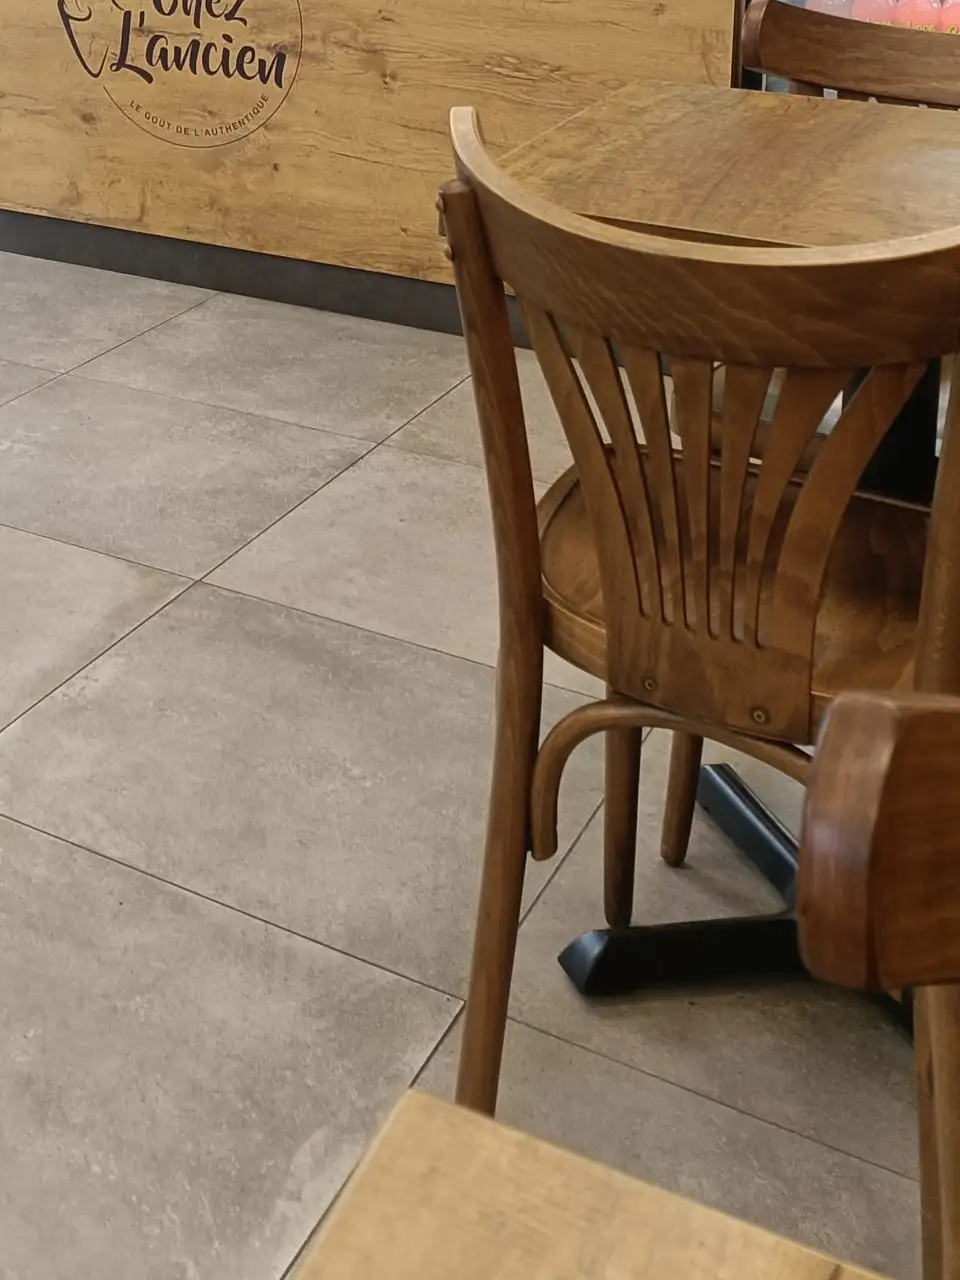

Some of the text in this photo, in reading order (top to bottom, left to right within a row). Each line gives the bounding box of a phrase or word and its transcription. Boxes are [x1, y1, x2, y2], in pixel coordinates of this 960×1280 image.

[110, 10, 287, 89] L'ancien
[130, 100, 142, 112] LE
[176, 125, 189, 136] DE
[194, 93, 269, 137] L'AUTHENTIQUE
